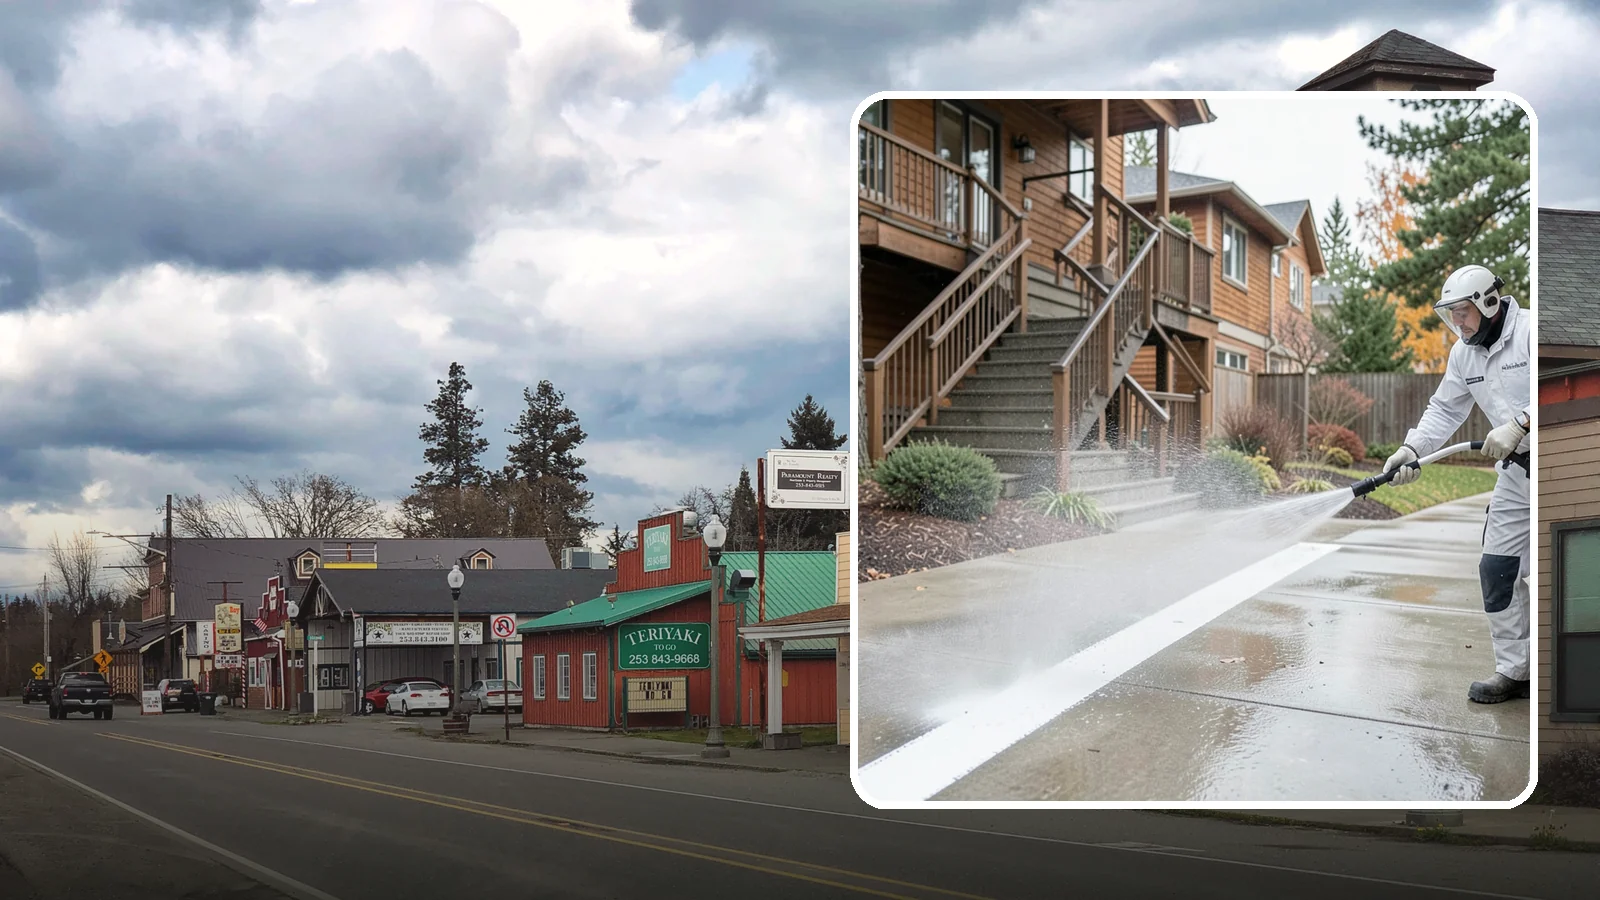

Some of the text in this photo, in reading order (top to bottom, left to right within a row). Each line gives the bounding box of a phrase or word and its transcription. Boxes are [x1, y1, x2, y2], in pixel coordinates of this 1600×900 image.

[781, 471, 839, 480] PARAMOUNT REALTY
[625, 627, 702, 646] TERIYAKI
[629, 654, 700, 664] 253 843-9668
